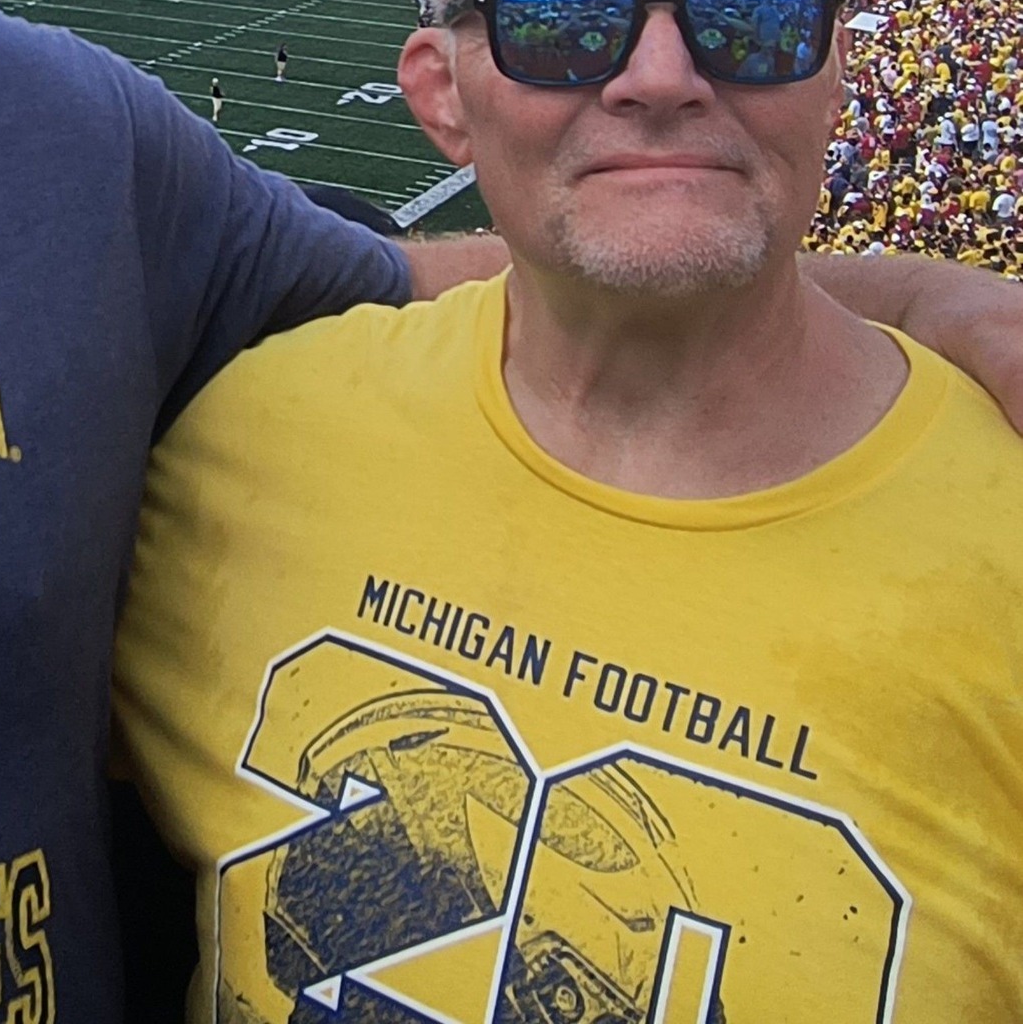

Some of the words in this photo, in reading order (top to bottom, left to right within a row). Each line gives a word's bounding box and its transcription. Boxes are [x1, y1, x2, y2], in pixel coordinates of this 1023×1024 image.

[342, 82, 404, 104] 20
[250, 127, 319, 151] 10
[357, 574, 552, 687] MICHIGAN
[562, 649, 818, 780] FOOTBALL
